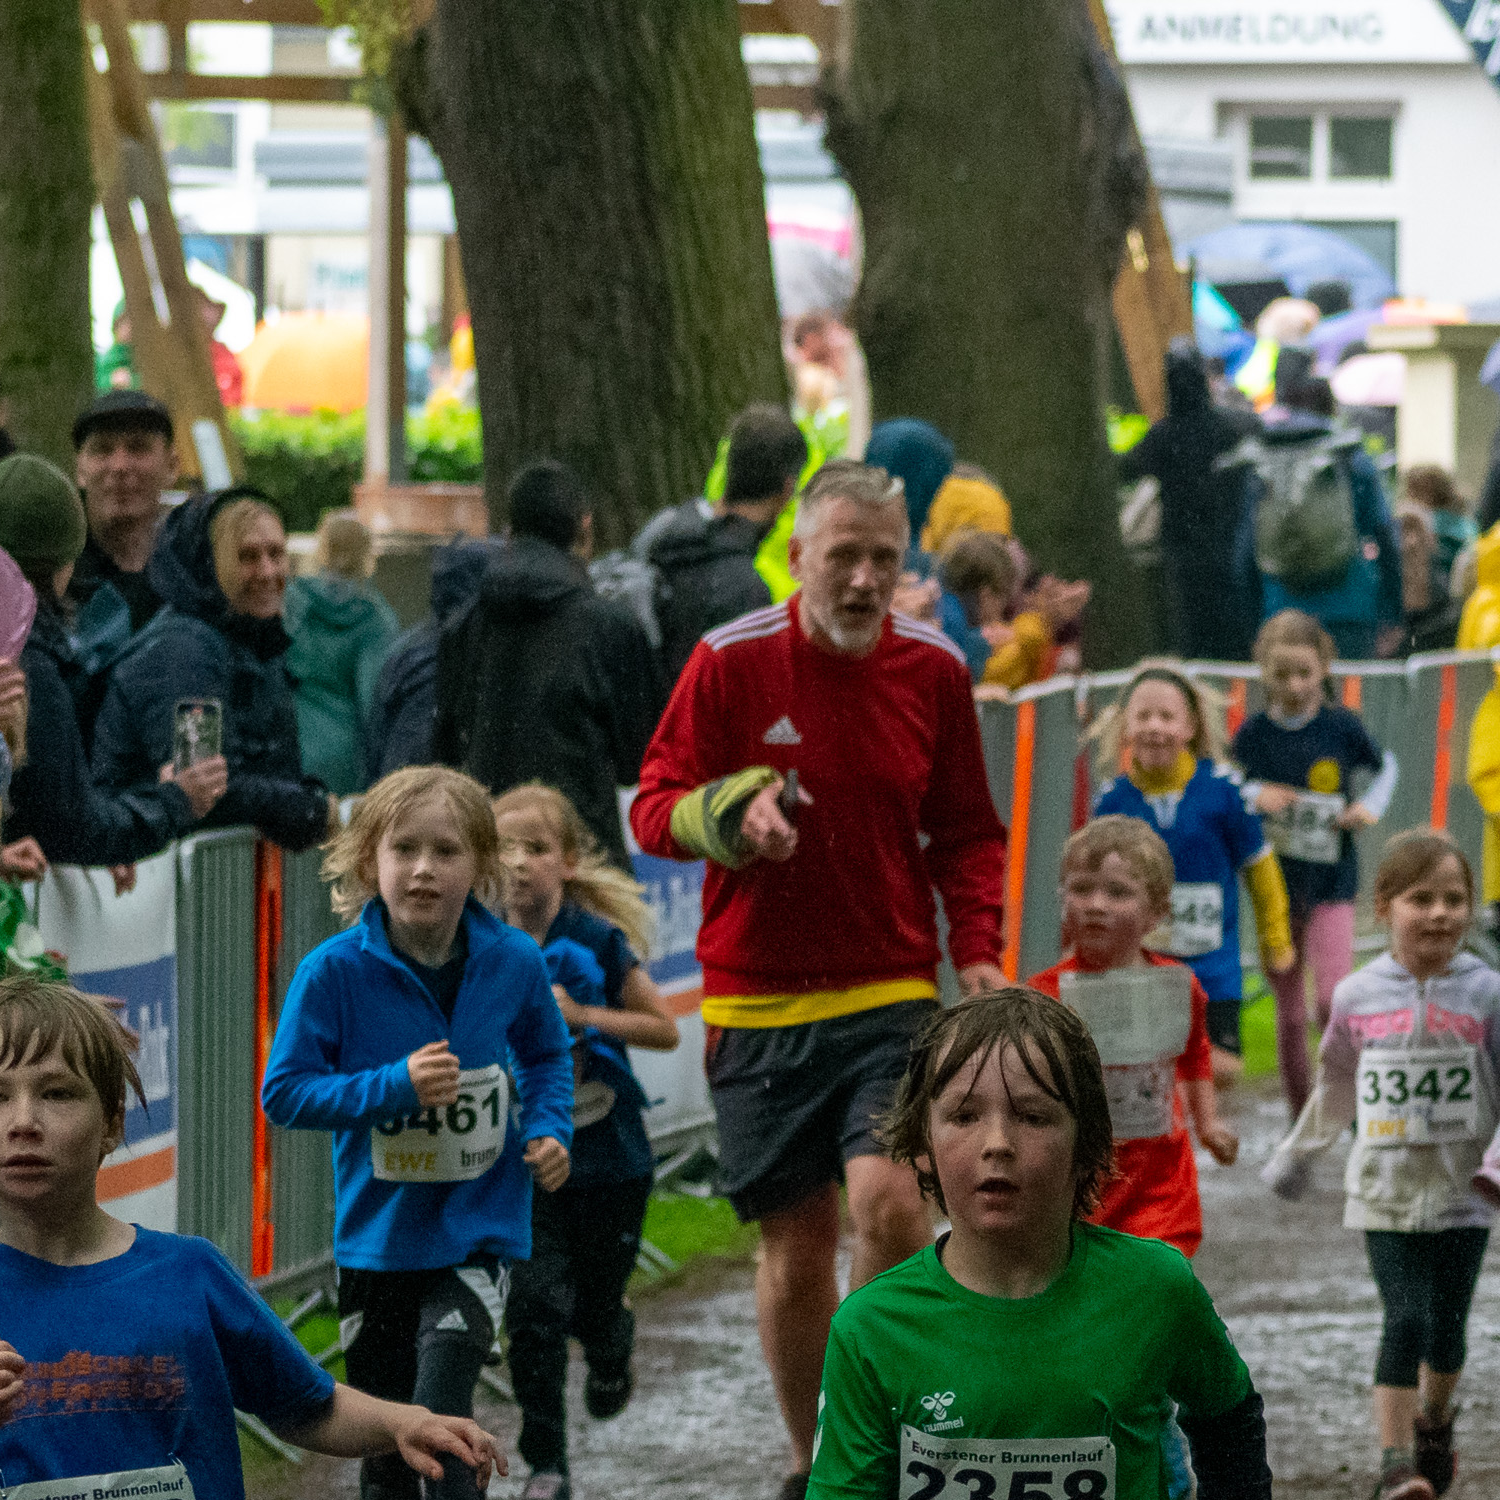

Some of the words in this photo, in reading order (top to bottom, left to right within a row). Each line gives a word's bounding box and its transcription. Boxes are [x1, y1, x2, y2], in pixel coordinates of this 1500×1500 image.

[1138, 12, 1384, 45] ANMELDUNG
[1363, 1067, 1472, 1105] 3342
[377, 1087, 500, 1137] 461
[384, 1152, 437, 1172] EWE
[911, 1440, 996, 1464] Everstener
[1001, 1450, 1104, 1465] Brunnenlauf
[92, 1477, 185, 1500] Brunnenlauf
